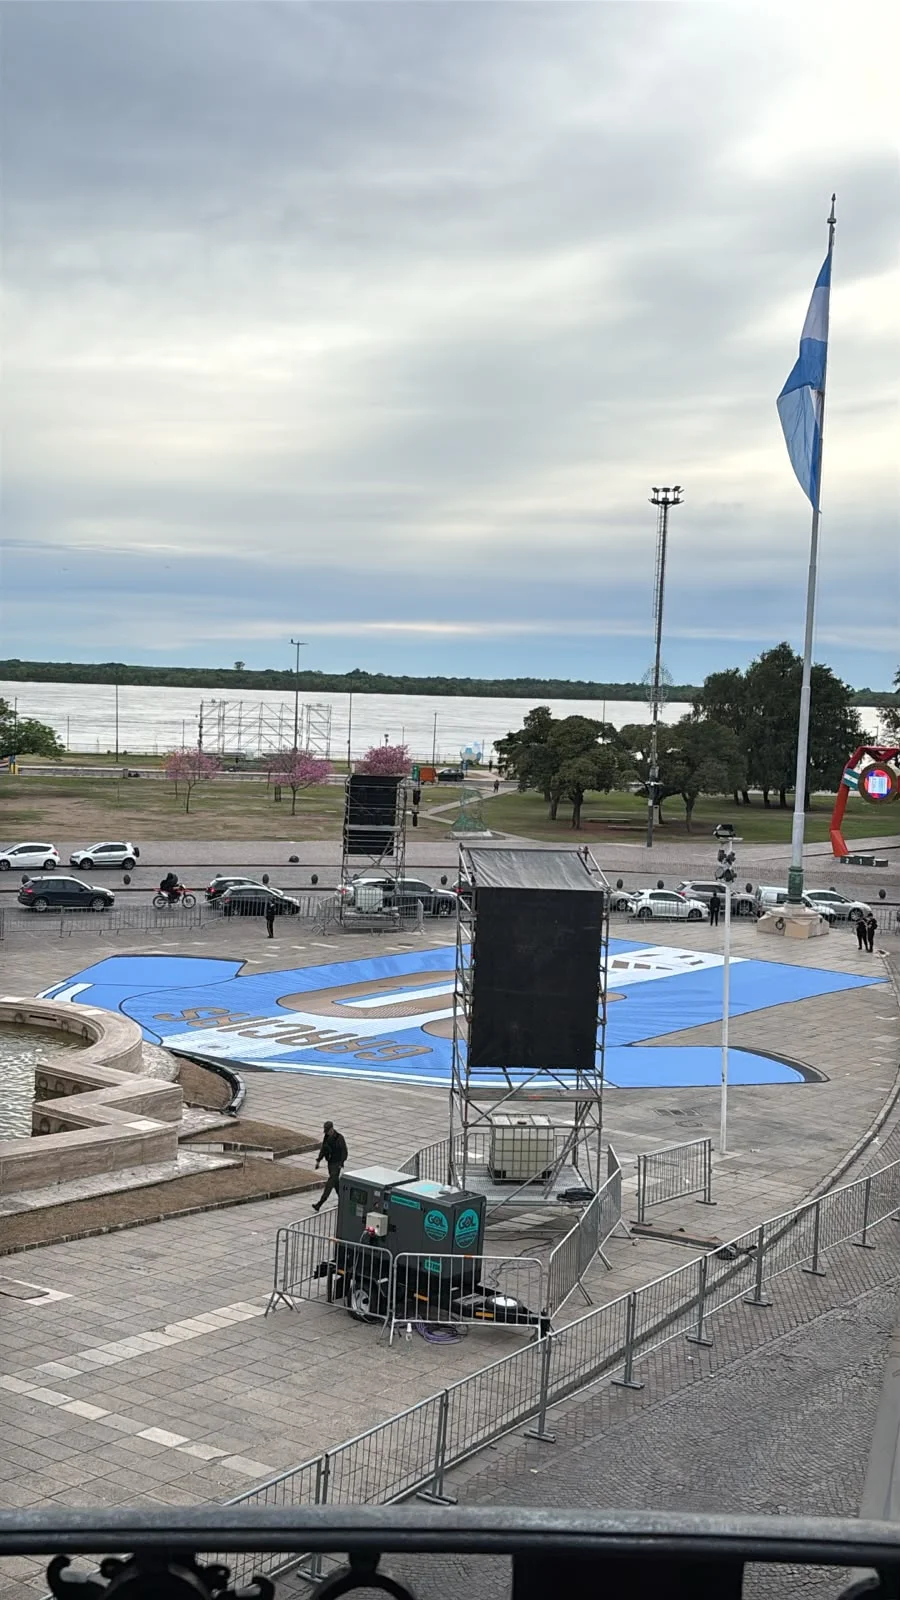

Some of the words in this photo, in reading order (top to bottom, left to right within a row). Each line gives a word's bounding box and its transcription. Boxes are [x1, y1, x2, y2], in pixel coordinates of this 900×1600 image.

[152, 1007, 433, 1062] GRACIAS
[428, 1214, 446, 1228] GOL
[458, 1215, 476, 1230] GOL
